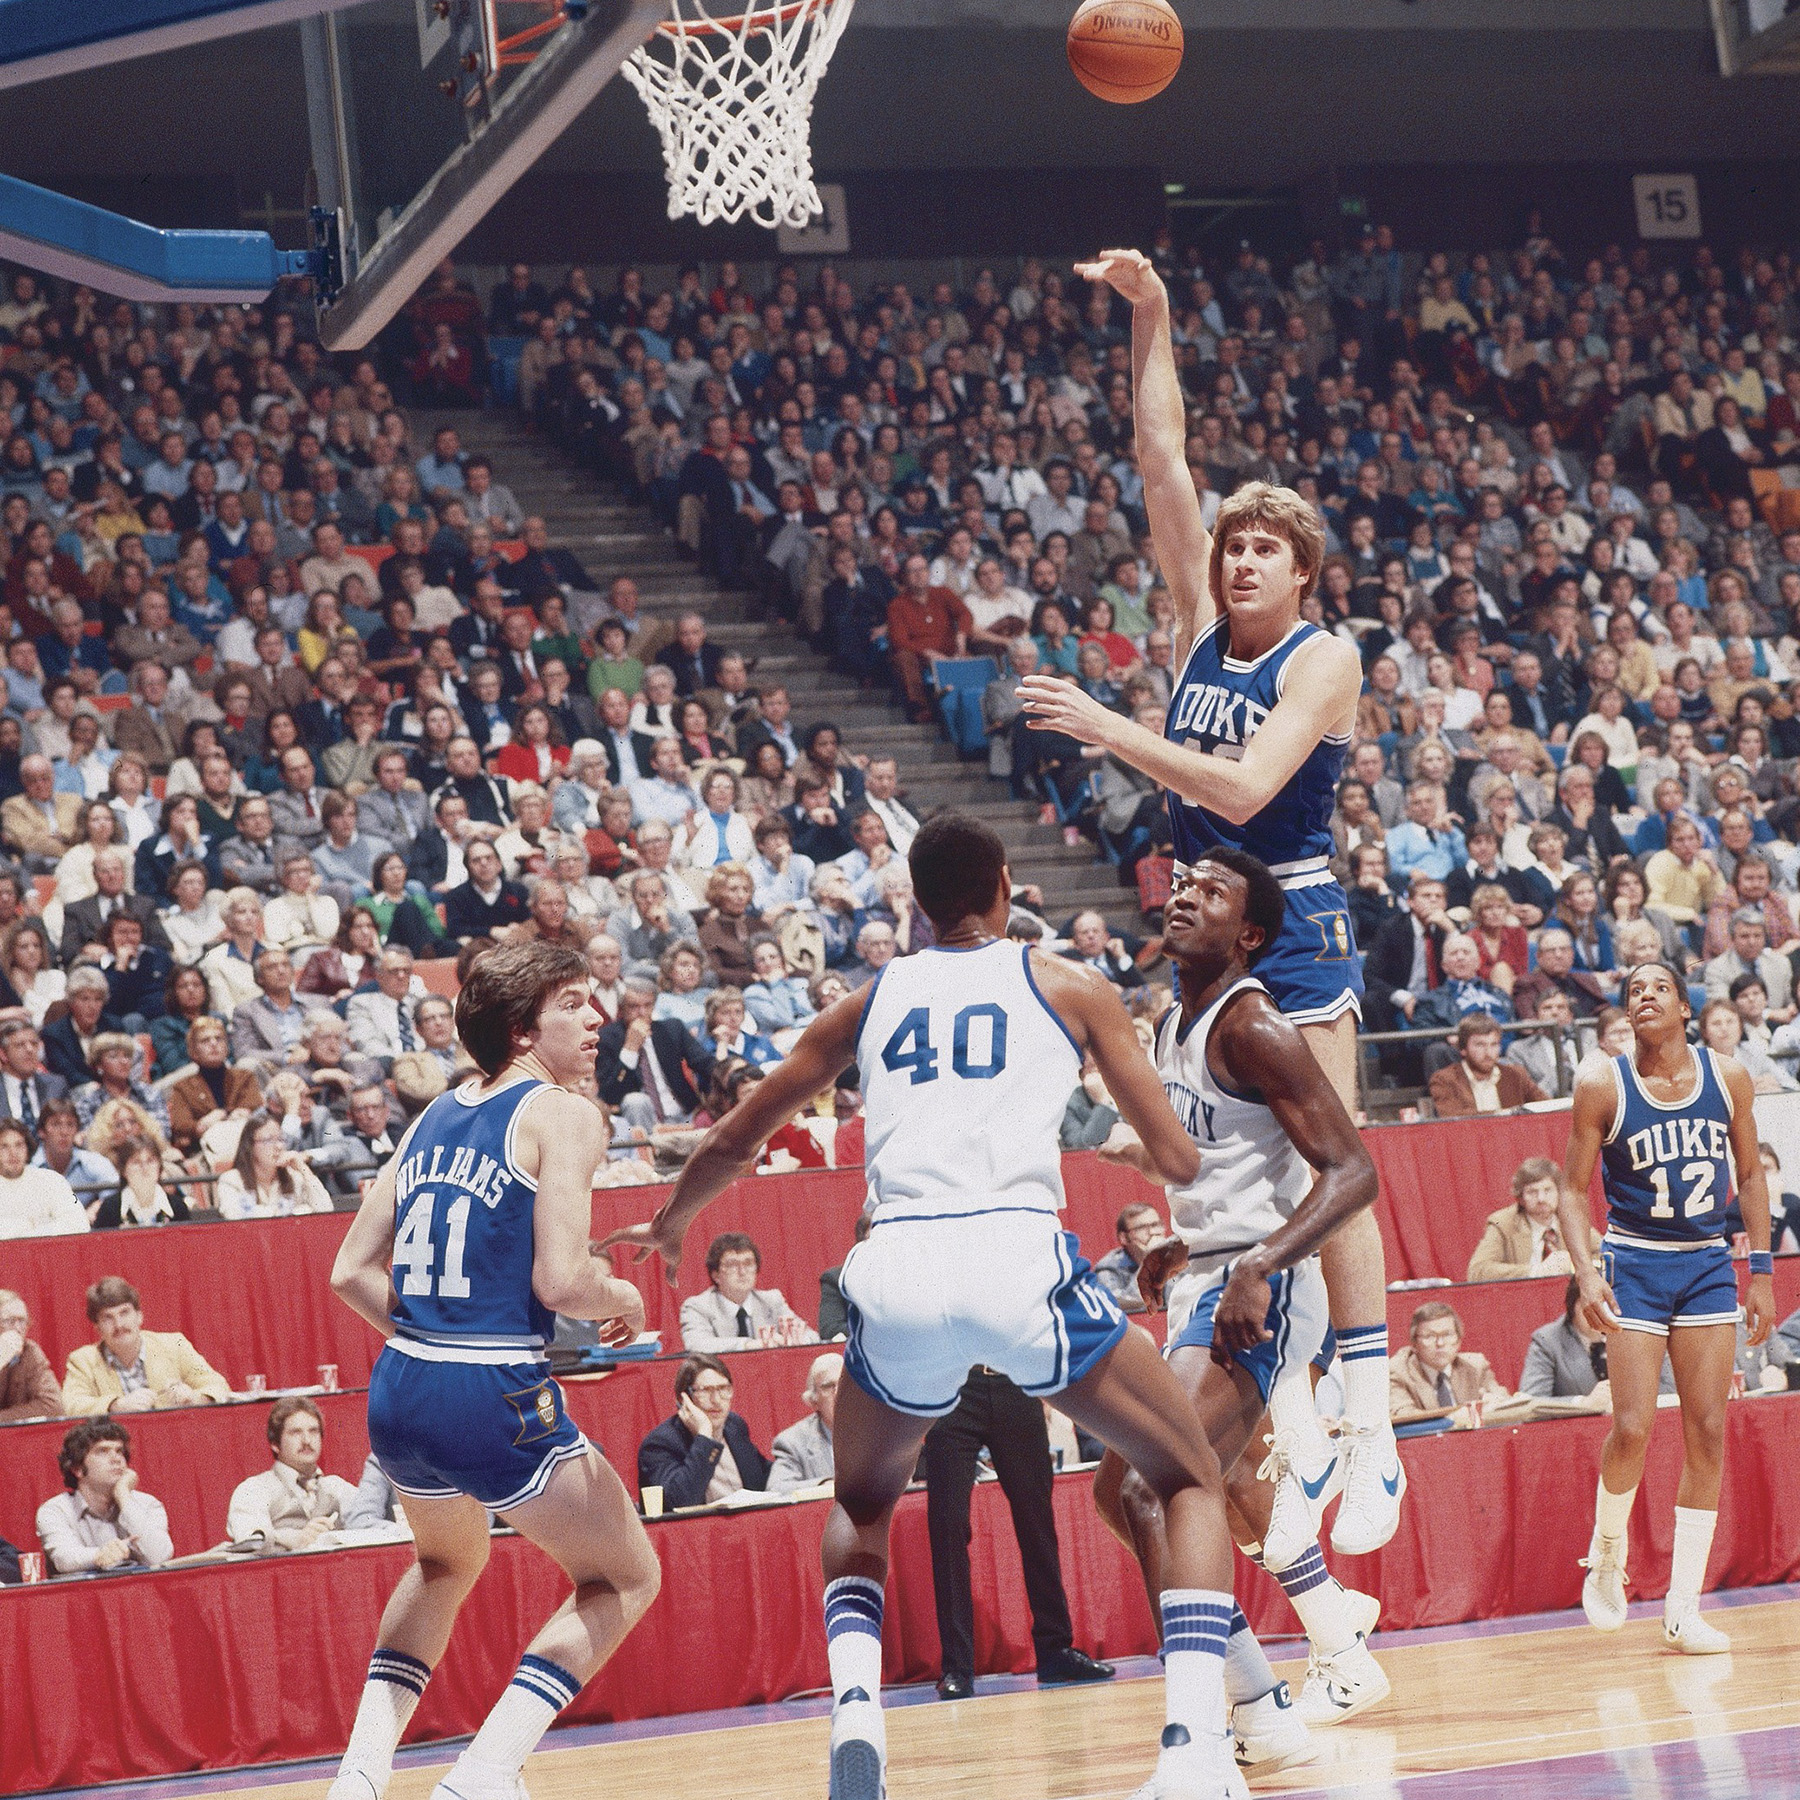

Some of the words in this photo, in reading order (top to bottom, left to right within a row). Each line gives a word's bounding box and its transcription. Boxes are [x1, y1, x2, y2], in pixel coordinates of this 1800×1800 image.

[1093, 15, 1172, 41] SPALDING
[1646, 189, 1687, 221] 15
[1174, 683, 1271, 746] DUKE
[881, 1002, 1008, 1086] 40
[1627, 1118, 1728, 1171] DUKE
[396, 1145, 513, 1209] WILLIAMS
[1650, 1160, 1715, 1218] 12
[392, 1192, 471, 1298] 41
